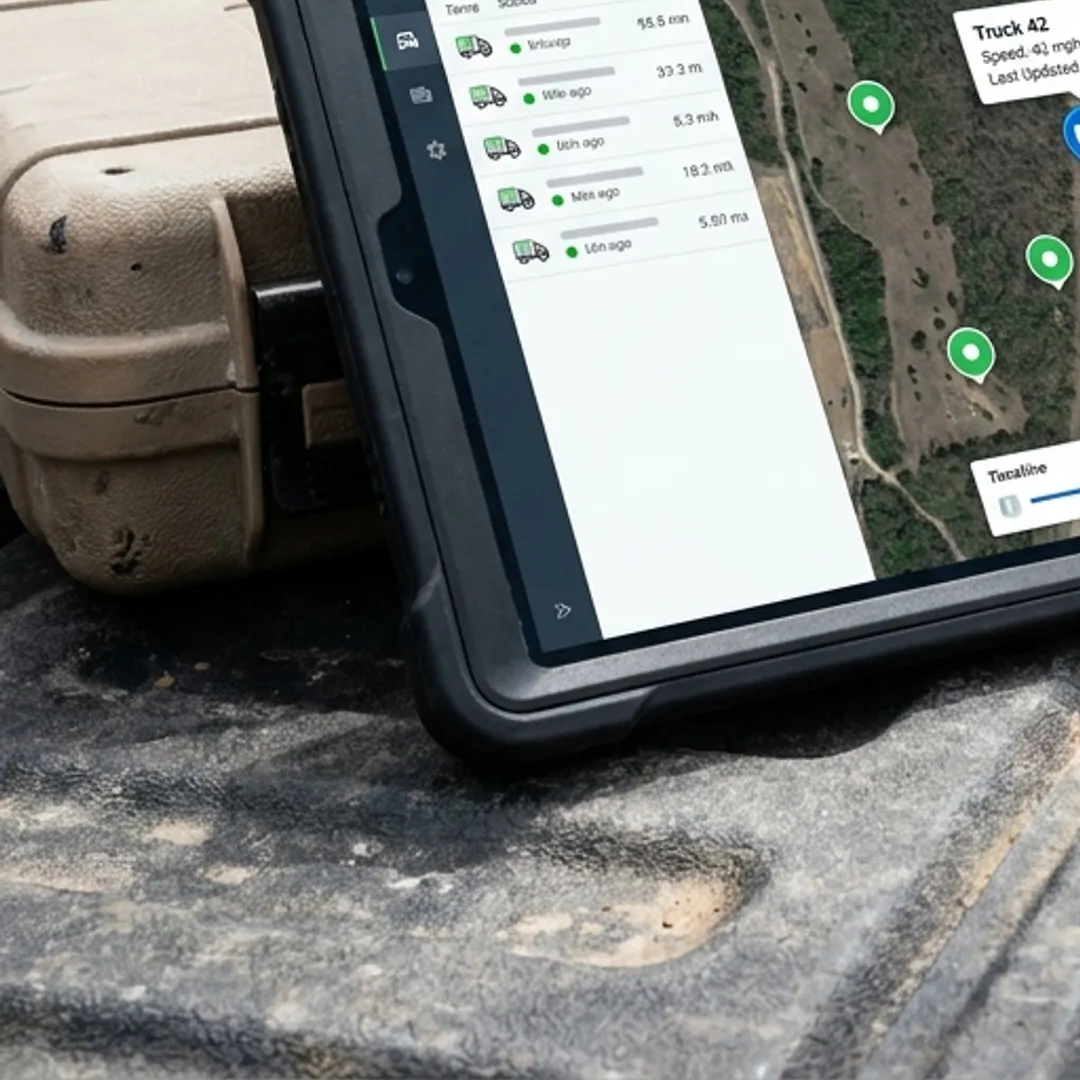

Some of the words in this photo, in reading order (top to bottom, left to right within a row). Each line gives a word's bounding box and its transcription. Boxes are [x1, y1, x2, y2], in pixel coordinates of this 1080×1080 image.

[972, 19, 1024, 40] Truck
[1027, 16, 1050, 33] 42
[988, 69, 1019, 86] Last
[582, 137, 605, 150] ago
[597, 187, 620, 201] ago
[608, 239, 632, 252] ago
